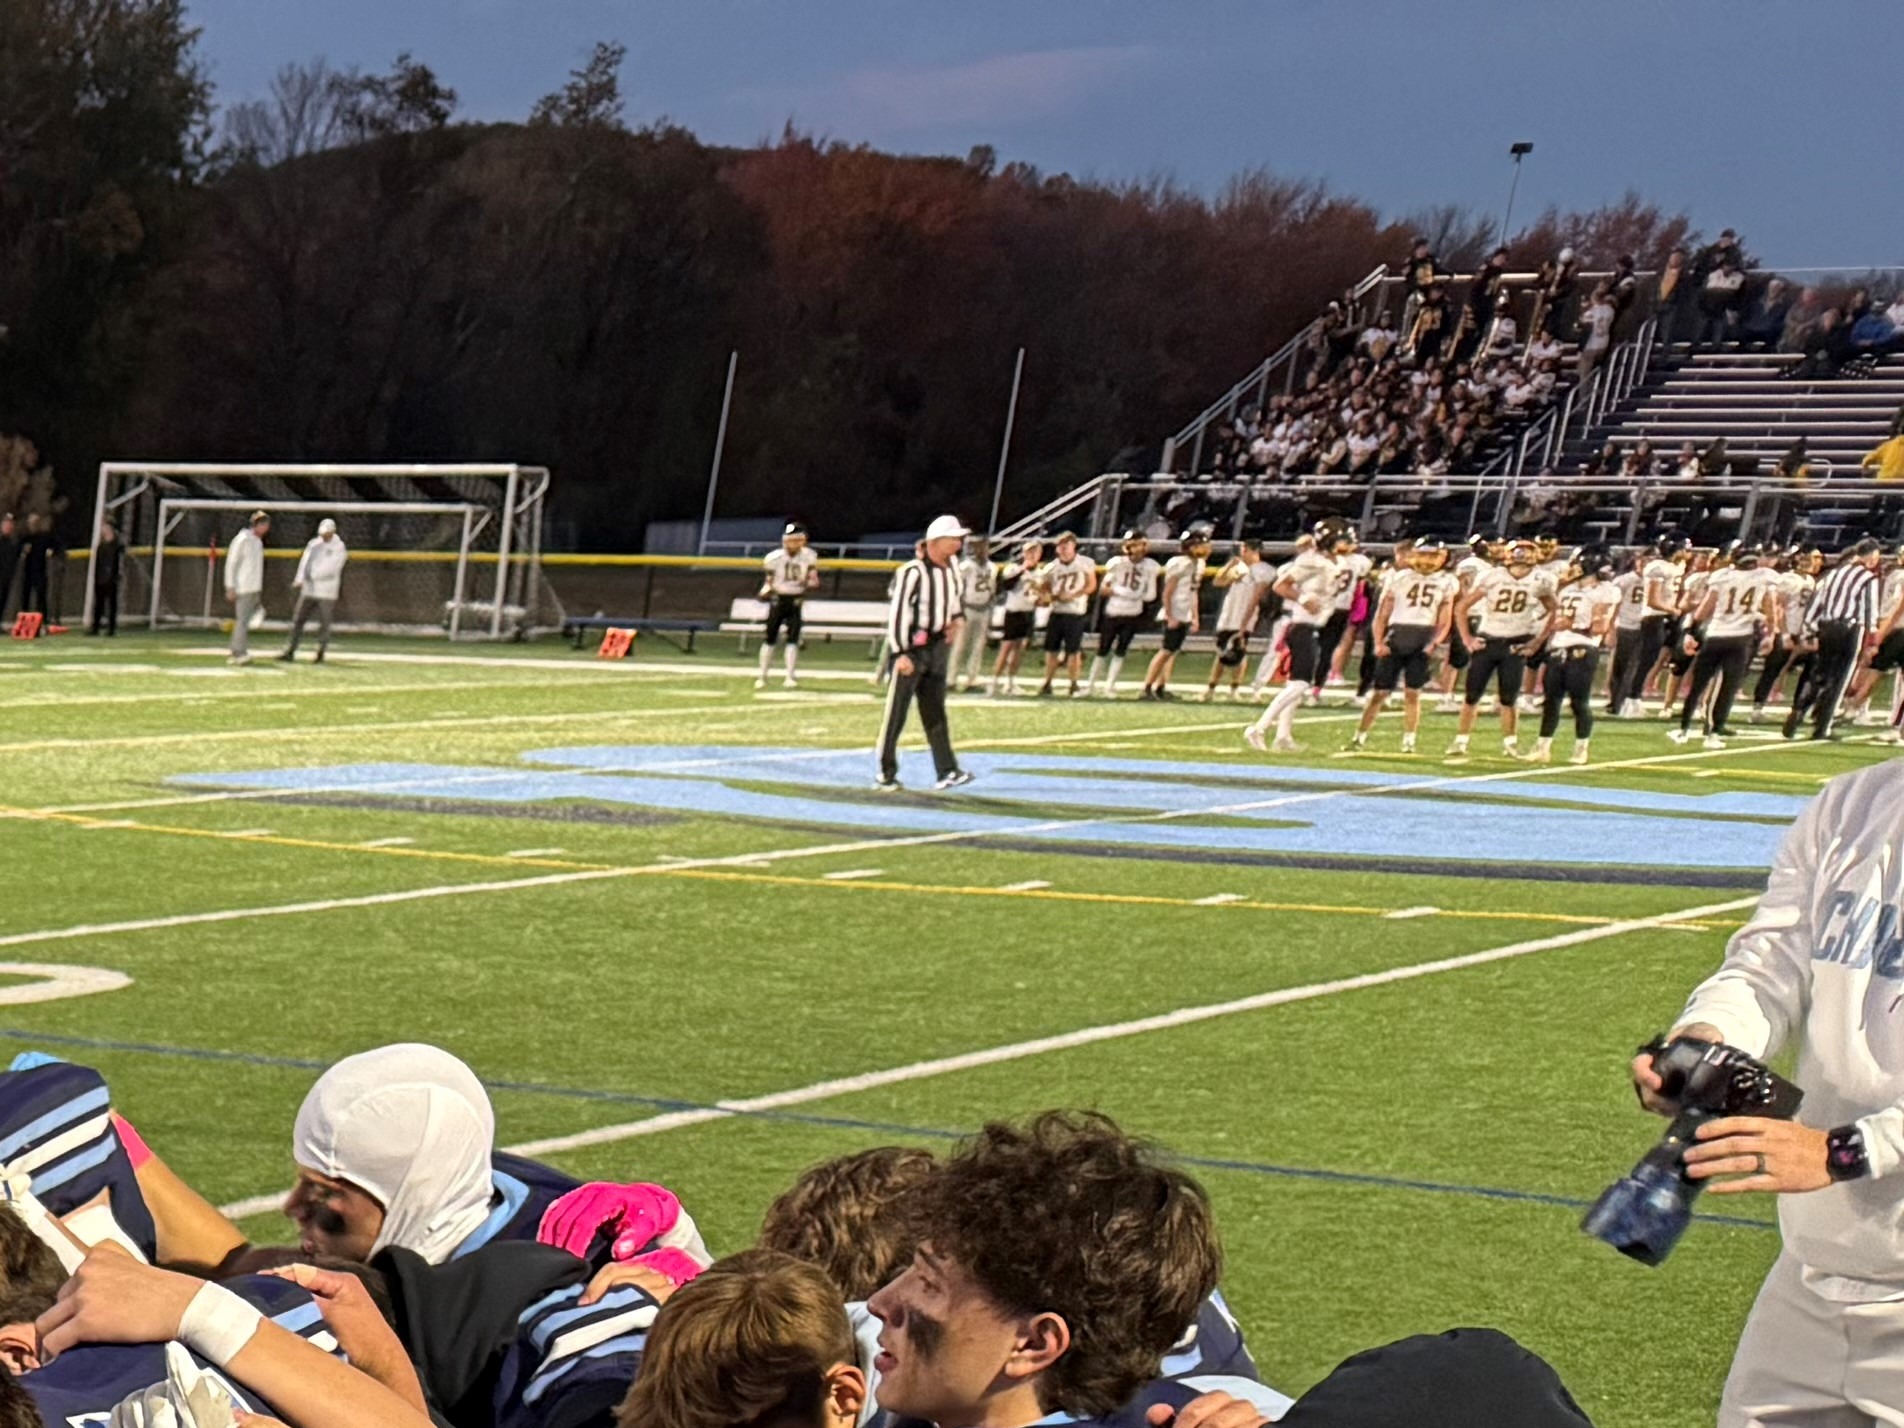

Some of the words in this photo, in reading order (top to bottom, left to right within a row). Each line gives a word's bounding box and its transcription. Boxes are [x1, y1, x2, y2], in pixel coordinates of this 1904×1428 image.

[1406, 582, 1437, 608] 45
[1494, 588, 1528, 613] 28
[1727, 586, 1755, 615] 14
